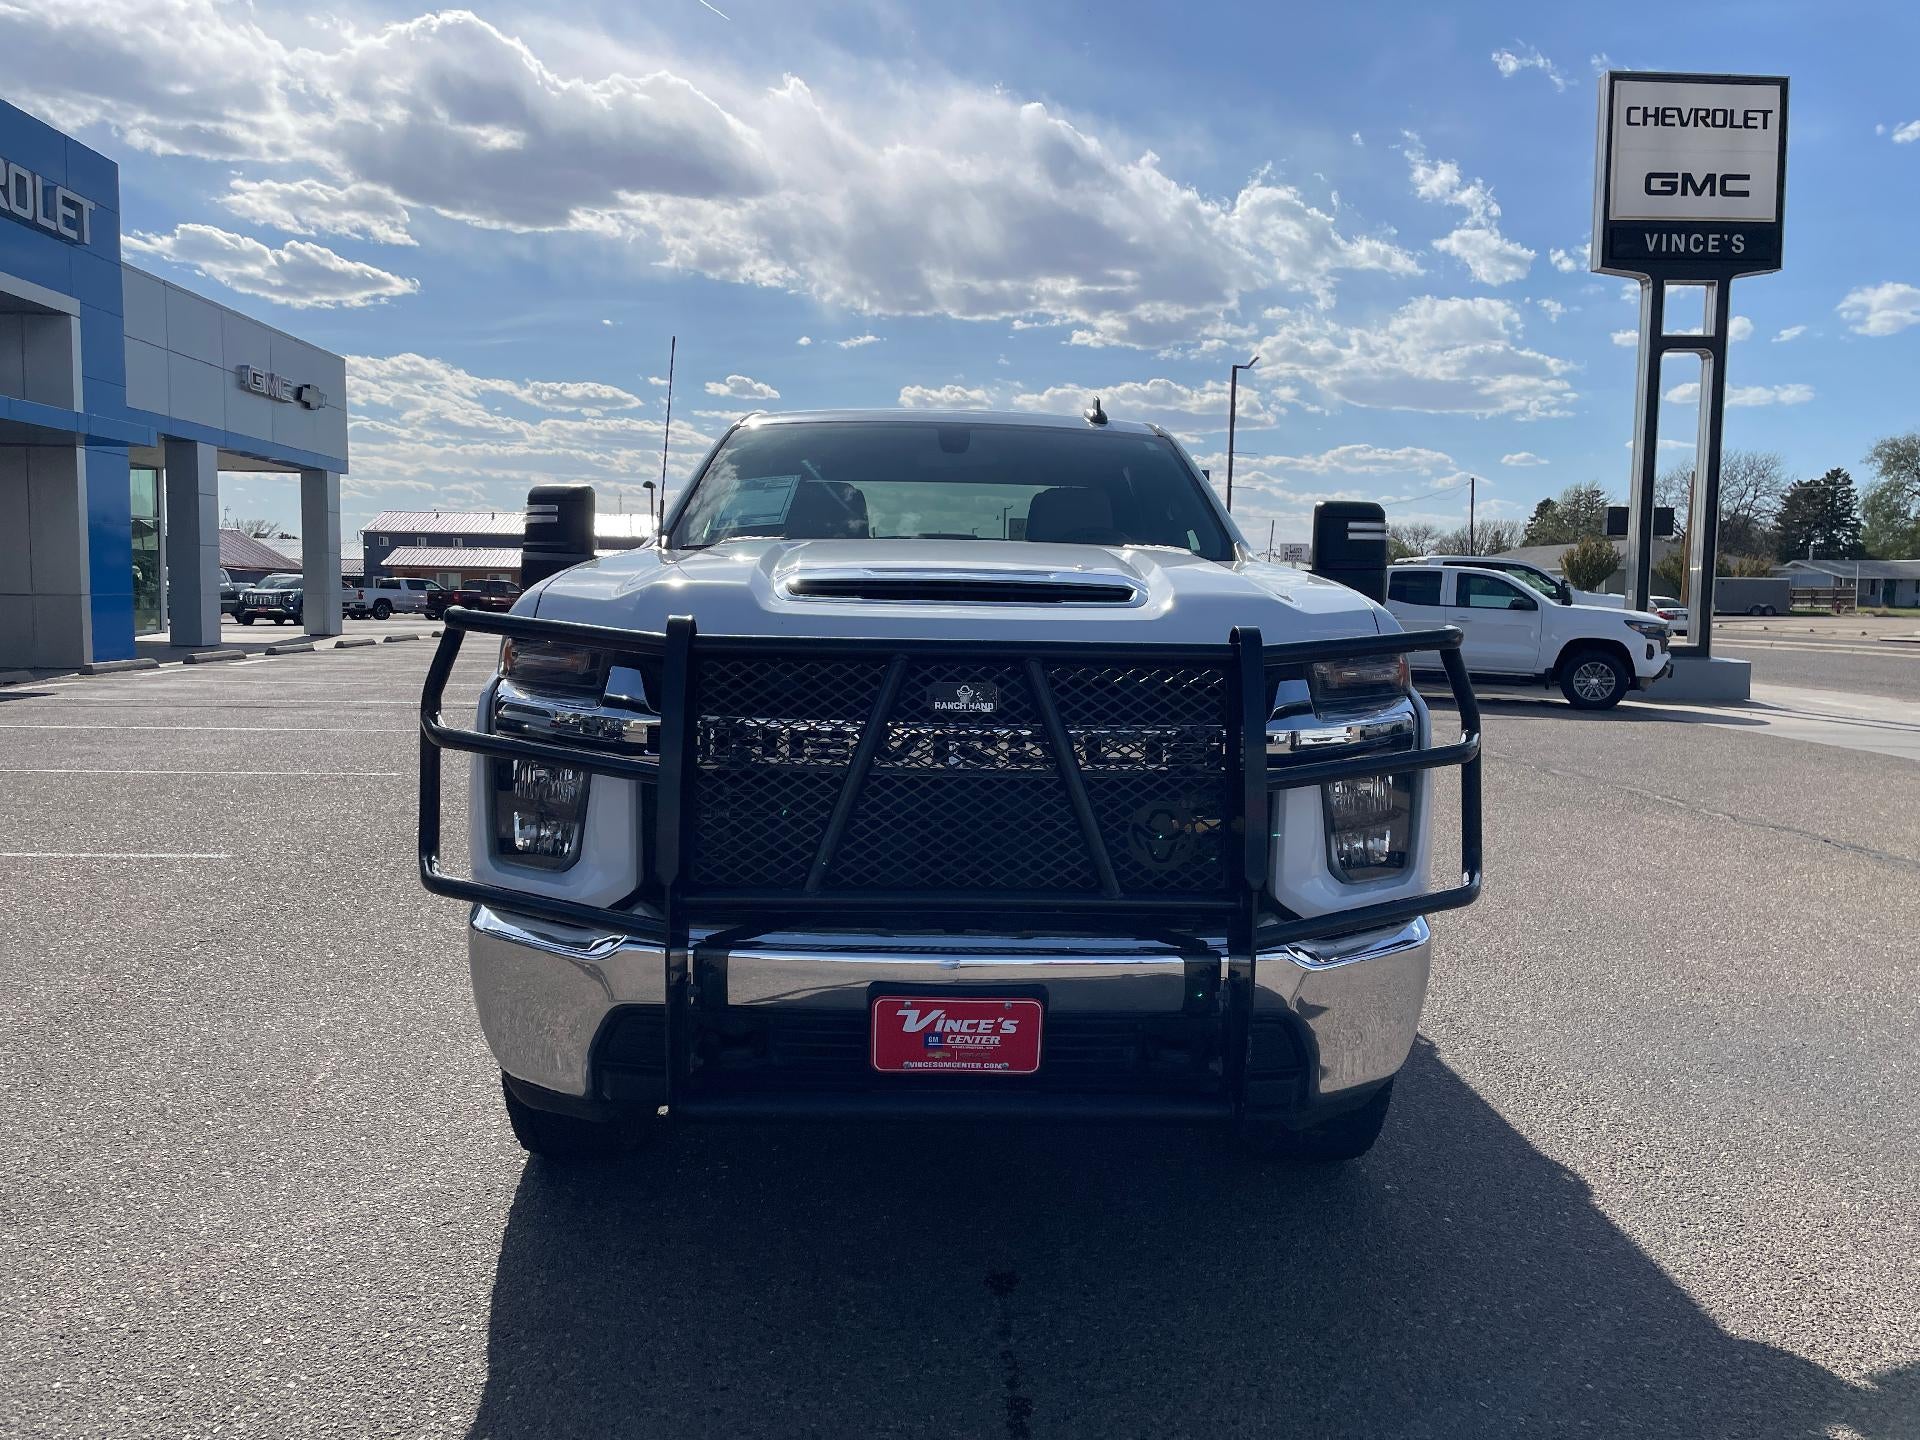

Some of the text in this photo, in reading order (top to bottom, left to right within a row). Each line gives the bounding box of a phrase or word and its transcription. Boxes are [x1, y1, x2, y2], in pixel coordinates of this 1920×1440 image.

[1626, 106, 1773, 130] CHEVROLET
[1644, 172, 1751, 198] GMC
[1645, 233, 1746, 254] VINCE'S
[248, 364, 295, 402] GMC
[934, 701, 994, 710] RANCH HAND
[946, 1034, 1001, 1045] CENTER
